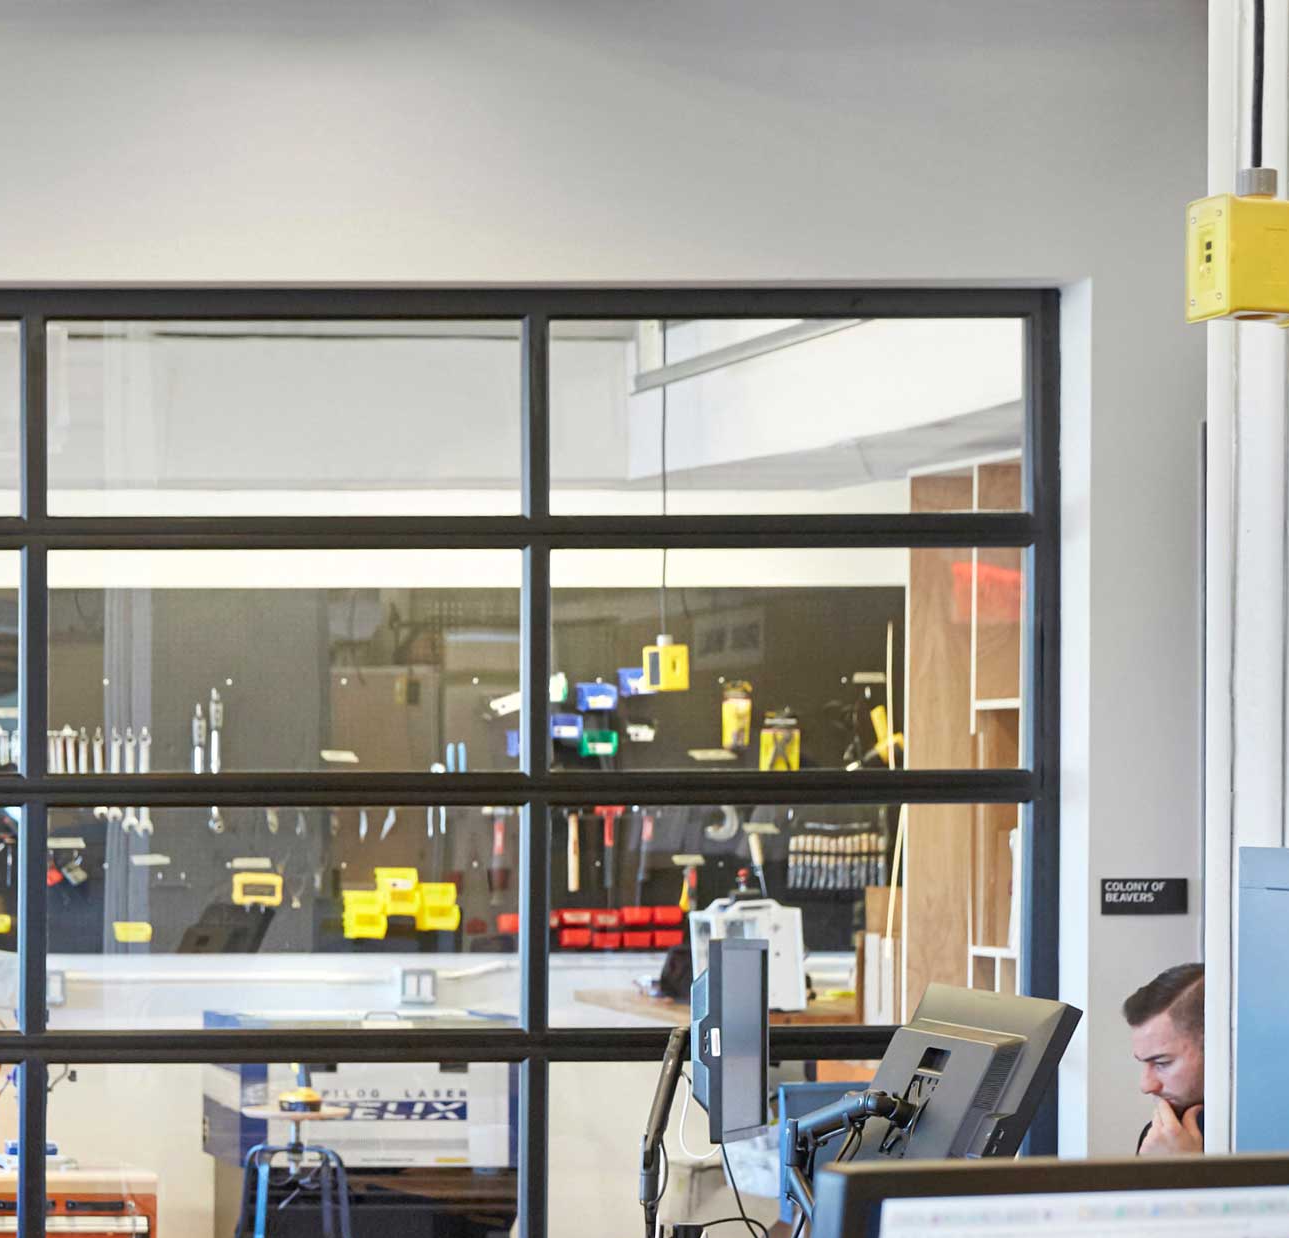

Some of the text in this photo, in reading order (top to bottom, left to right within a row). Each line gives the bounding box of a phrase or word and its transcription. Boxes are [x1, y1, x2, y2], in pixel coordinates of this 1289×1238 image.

[1104, 881, 1166, 892] COLONY OF
[1104, 892, 1155, 903] BEAVERS
[321, 1088, 468, 1099] PILOG LASER
